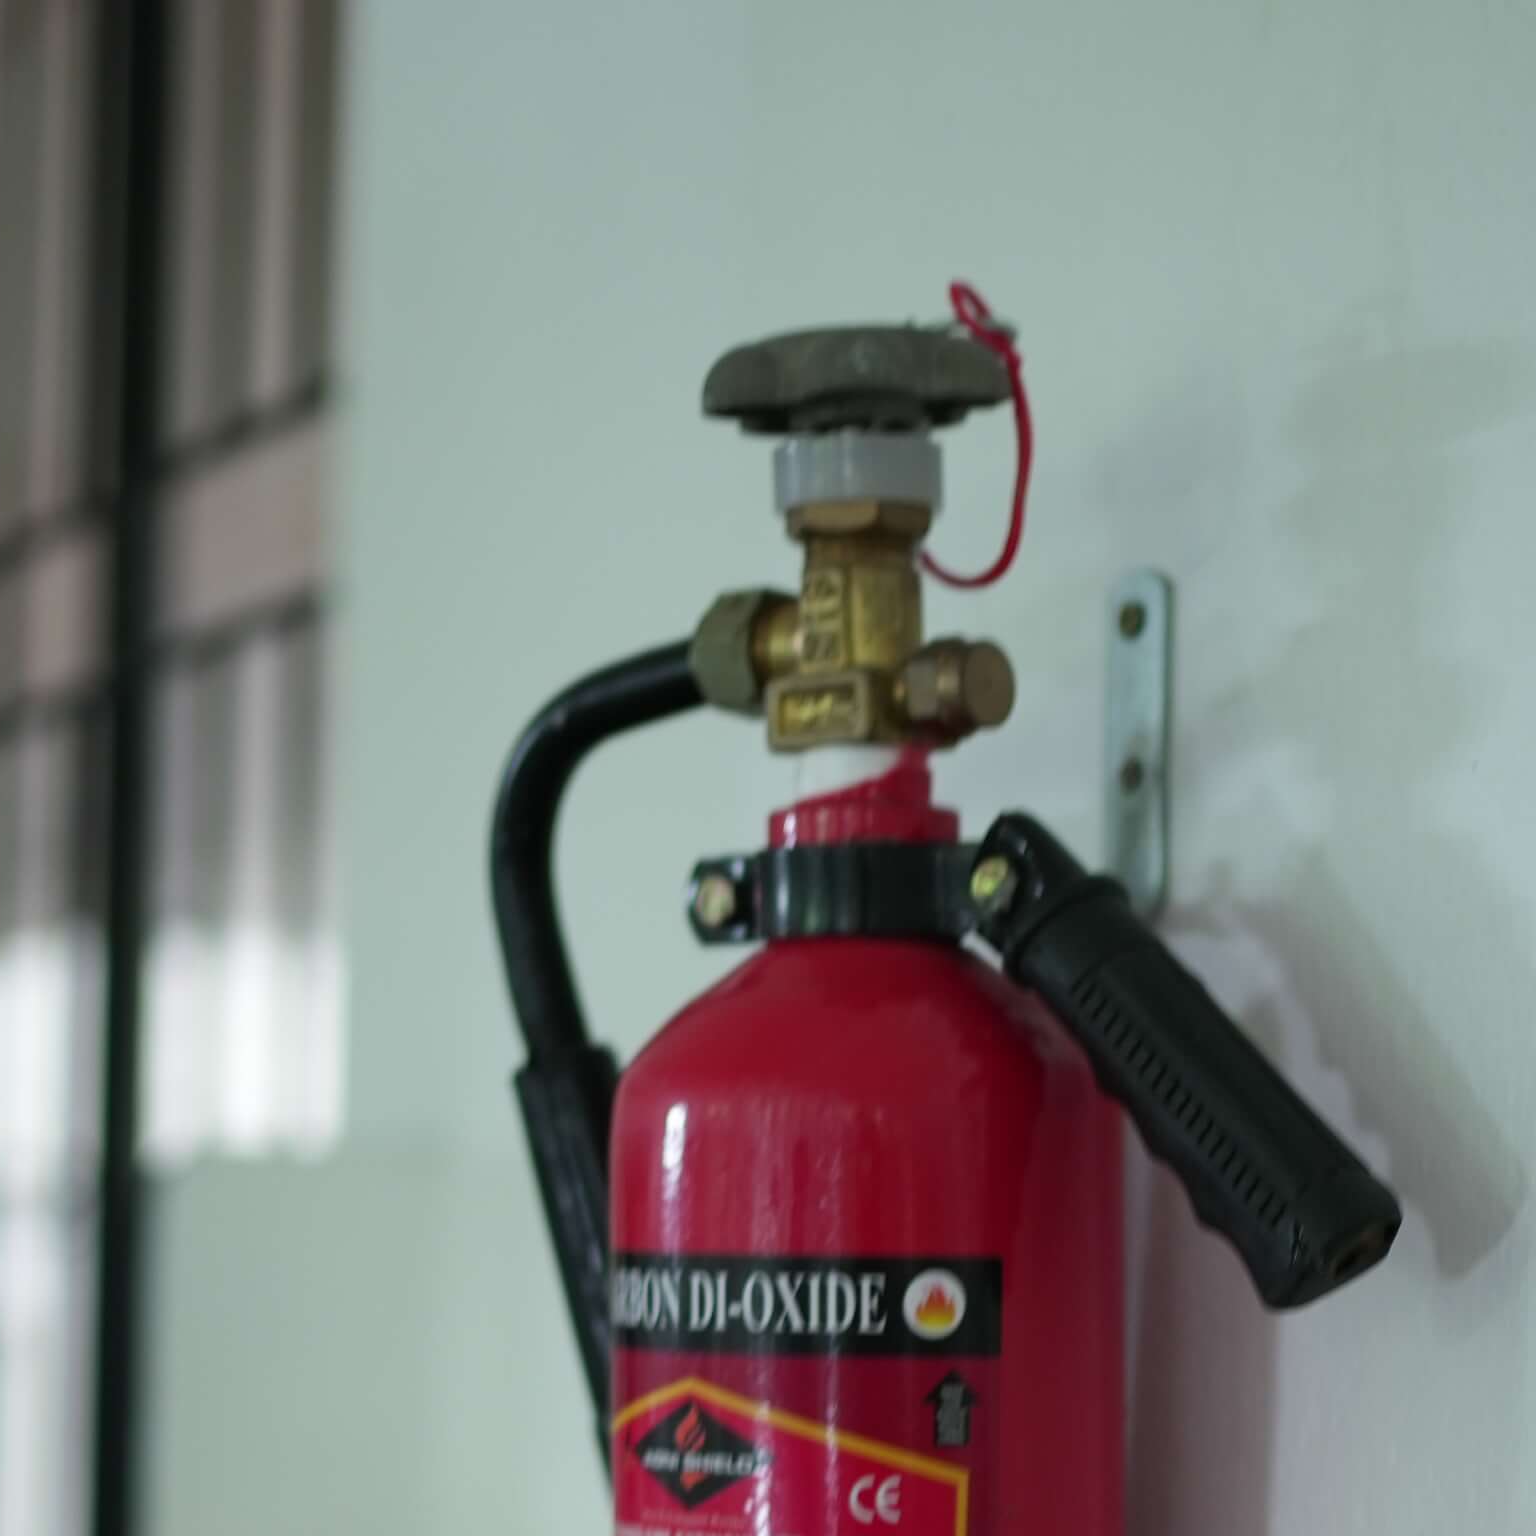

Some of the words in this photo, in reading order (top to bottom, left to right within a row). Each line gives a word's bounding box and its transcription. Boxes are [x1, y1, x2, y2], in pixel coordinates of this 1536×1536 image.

[610, 1268, 682, 1331] RBON
[689, 1269, 888, 1336] DI-OXIDE
[849, 1474, 902, 1524] CE
